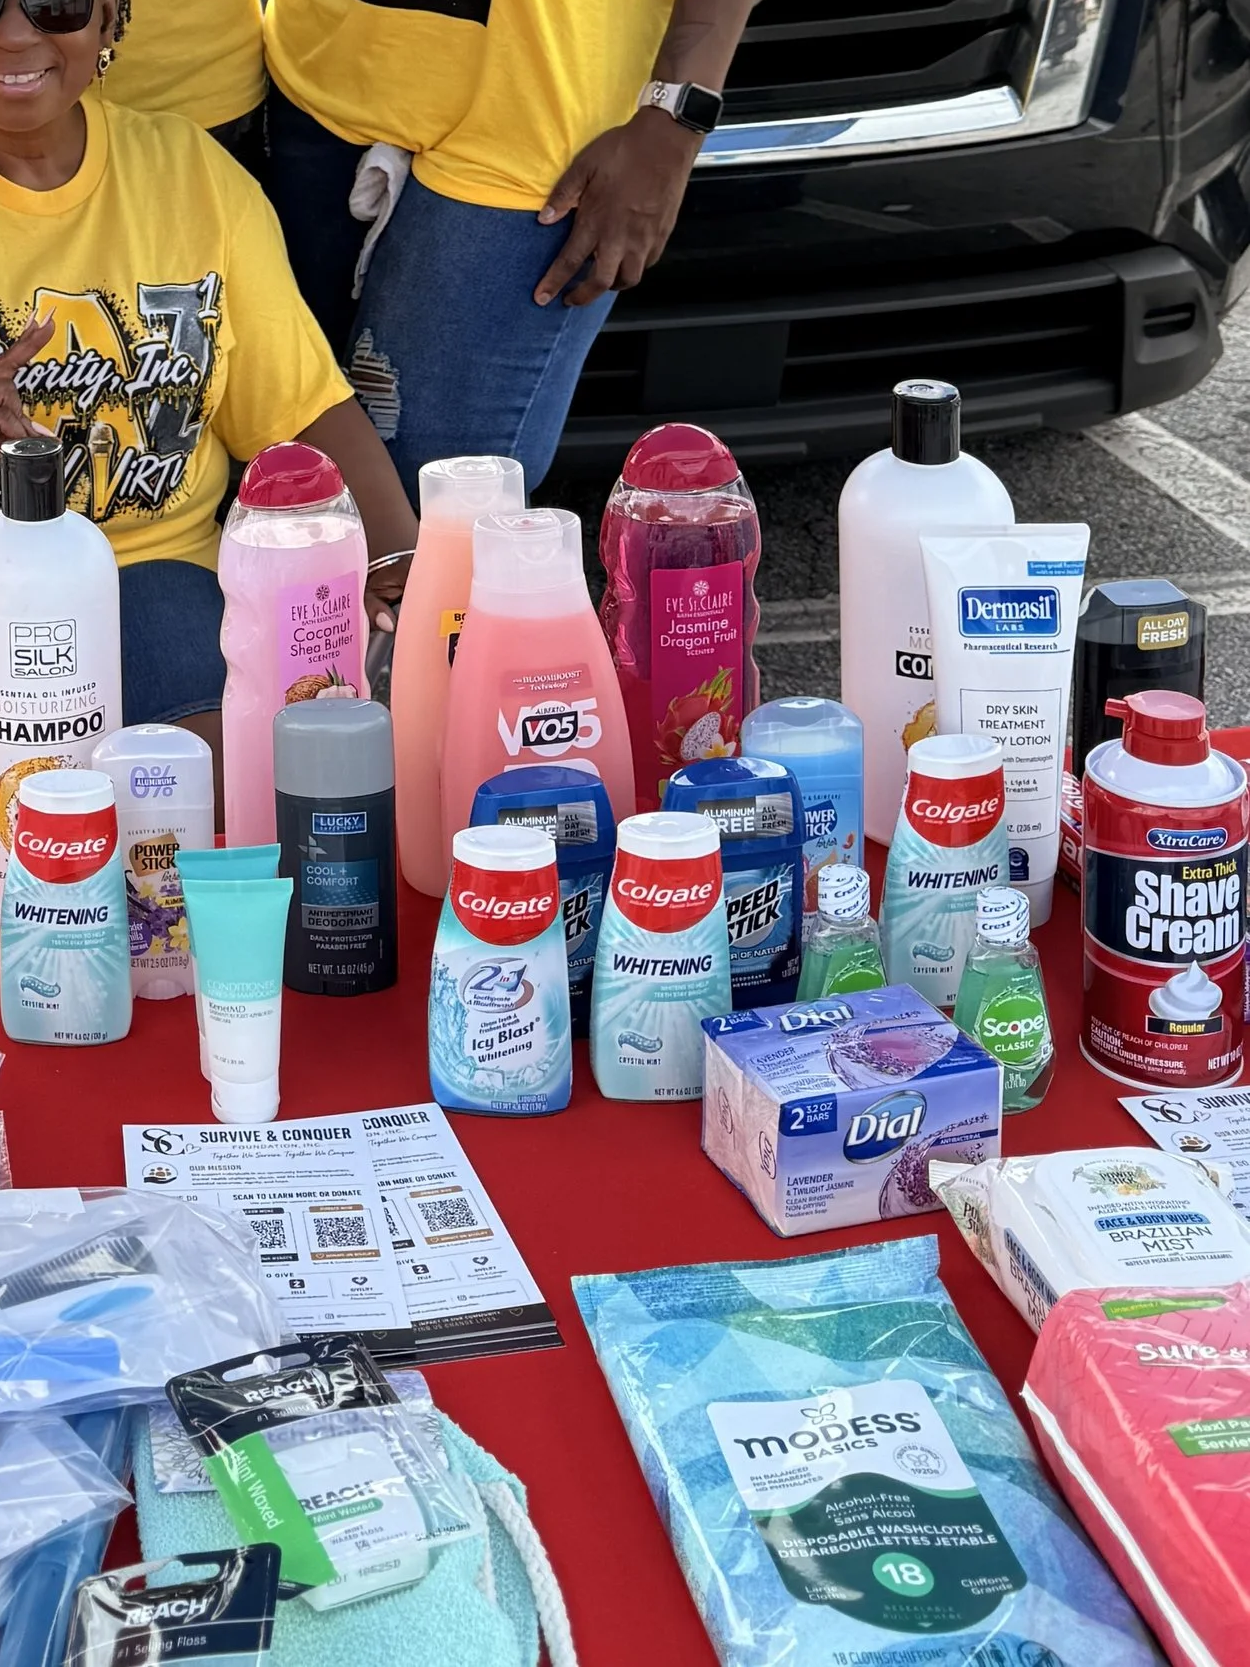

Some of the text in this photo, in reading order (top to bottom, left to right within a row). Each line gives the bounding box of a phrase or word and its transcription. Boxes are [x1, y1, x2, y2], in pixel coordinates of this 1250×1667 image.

[666, 595, 684, 614] EVE
[966, 595, 1053, 621] Dermasil
[291, 605, 308, 622] EVE
[293, 619, 351, 643] Coconut
[668, 617, 729, 635] Jasmine
[995, 623, 1025, 632] LABS
[1142, 617, 1186, 631] ALL-DAY
[14, 624, 73, 644] PRO
[660, 629, 737, 650] Dragon Fruit
[1140, 628, 1188, 644] FRESH
[290, 633, 354, 658] Shea Butter
[686, 648, 715, 656] SCENTED
[963, 642, 1058, 653] Pharmaceutical Research
[14, 646, 73, 666] SILK
[308, 650, 341, 664] SCENTED
[14, 665, 74, 677] SALON
[42, 691, 57, 699] OIL
[61, 682, 97, 697] INFUSED
[535, 705, 566, 716] ALBERTO
[986, 704, 1039, 716] DRY SKIN
[524, 715, 576, 743] VO5
[978, 719, 1046, 731] TREATMENT
[1010, 735, 1051, 746] LOTION
[136, 777, 174, 786] ALUMINUM
[703, 806, 756, 819] ALUMINUM
[761, 805, 776, 814] ALL
[805, 809, 836, 823] WER
[911, 795, 999, 822] Colgate
[320, 816, 360, 827] LUCKY
[505, 814, 557, 826] ALUMINUM
[564, 813, 579, 822] ALL
[761, 813, 778, 822] DAY
[761, 820, 787, 830] FRESH
[564, 821, 580, 830] DAY
[18, 830, 107, 861] Colgate
[1154, 832, 1223, 847] XtraCare
[135, 843, 180, 861] POWER
[142, 857, 177, 871] STICK
[306, 865, 336, 877] COOL
[1182, 858, 1238, 880] Extra Thick
[306, 876, 359, 886] COMFORT
[908, 864, 998, 889] WHITENING
[618, 878, 713, 909] Colgate
[1134, 869, 1241, 918] Shave
[458, 890, 552, 920] Colgate
[15, 902, 109, 926] WHITENING
[308, 908, 374, 918] ANTIPERSPIRANT
[308, 916, 374, 927] DEODORANT
[310, 934, 373, 942] DAILY PROTECTION
[1125, 905, 1241, 956] Cream
[753, 943, 788, 958] NATURE
[568, 955, 595, 968] NATUR
[613, 953, 712, 977] WHITENING
[718, 1016, 732, 1032] 2
[780, 1005, 853, 1032] Dial
[983, 1013, 1045, 1039] Scope
[1169, 1021, 1206, 1034] Regular
[472, 1021, 535, 1052] Icy Blast
[478, 1040, 533, 1064] Whitening
[994, 1038, 1035, 1053] CLASSIC
[1144, 1057, 1187, 1070] PRESSURE.
[1208, 1055, 1221, 1071] NET
[1197, 1093, 1250, 1109] SURVIV
[362, 1111, 431, 1131] CONQUER
[790, 1102, 833, 1131] 2 3.2 OZ
[806, 1113, 830, 1123] BARS
[847, 1106, 923, 1147] Dial
[200, 1127, 352, 1144] SURVIVE & CONQUER
[940, 1133, 982, 1145] ANTIBACTERIAL
[232, 1143, 302, 1151] FOUNDATION,
[207, 1164, 242, 1172] MISSION
[392, 1171, 458, 1186] MORE OR DONATE
[787, 1173, 834, 1187] LAVENDER
[232, 1193, 254, 1201] SCAN
[268, 1192, 294, 1200] LEARN
[319, 1191, 330, 1199] OR
[331, 1189, 362, 1197] DONATE
[792, 1180, 855, 1197] TWILIGHT JASMINE
[785, 1201, 827, 1212] NON-DRYING
[786, 1194, 835, 1205] CLEAN RINSING,
[1087, 1202, 1122, 1212] INFUSED
[1099, 1212, 1204, 1230] FACE & BODY WIPES
[1109, 1225, 1214, 1243] BRAZILIAN
[1142, 1238, 1195, 1253] MIST
[1134, 1342, 1248, 1362] Sure &
[243, 1375, 321, 1403] REACH
[1186, 1420, 1226, 1433] Maxi
[803, 1438, 879, 1462] BASICS
[1198, 1435, 1250, 1450] Servie
[762, 1466, 809, 1481] BALANCED
[767, 1472, 812, 1487] PARABENS
[769, 1475, 824, 1491] PHTHALATES
[248, 1479, 285, 1530] Waxed
[825, 1493, 911, 1513] Alcohol-Free
[312, 1500, 376, 1524] Mint Waxed
[834, 1508, 915, 1527] Sans Alcool
[782, 1523, 983, 1548] DISPOSABLE WASHCLOTHS
[778, 1534, 998, 1559] DÉBARBOUILLETTES JETABLE
[881, 1562, 926, 1585] 18
[961, 1575, 1010, 1588] Chiffons
[971, 1582, 1014, 1596] Grande
[125, 1598, 208, 1627] REACH
[177, 1635, 207, 1648] Floss
[833, 1647, 949, 1666] 18 CLOTHS/CHIFFONS
